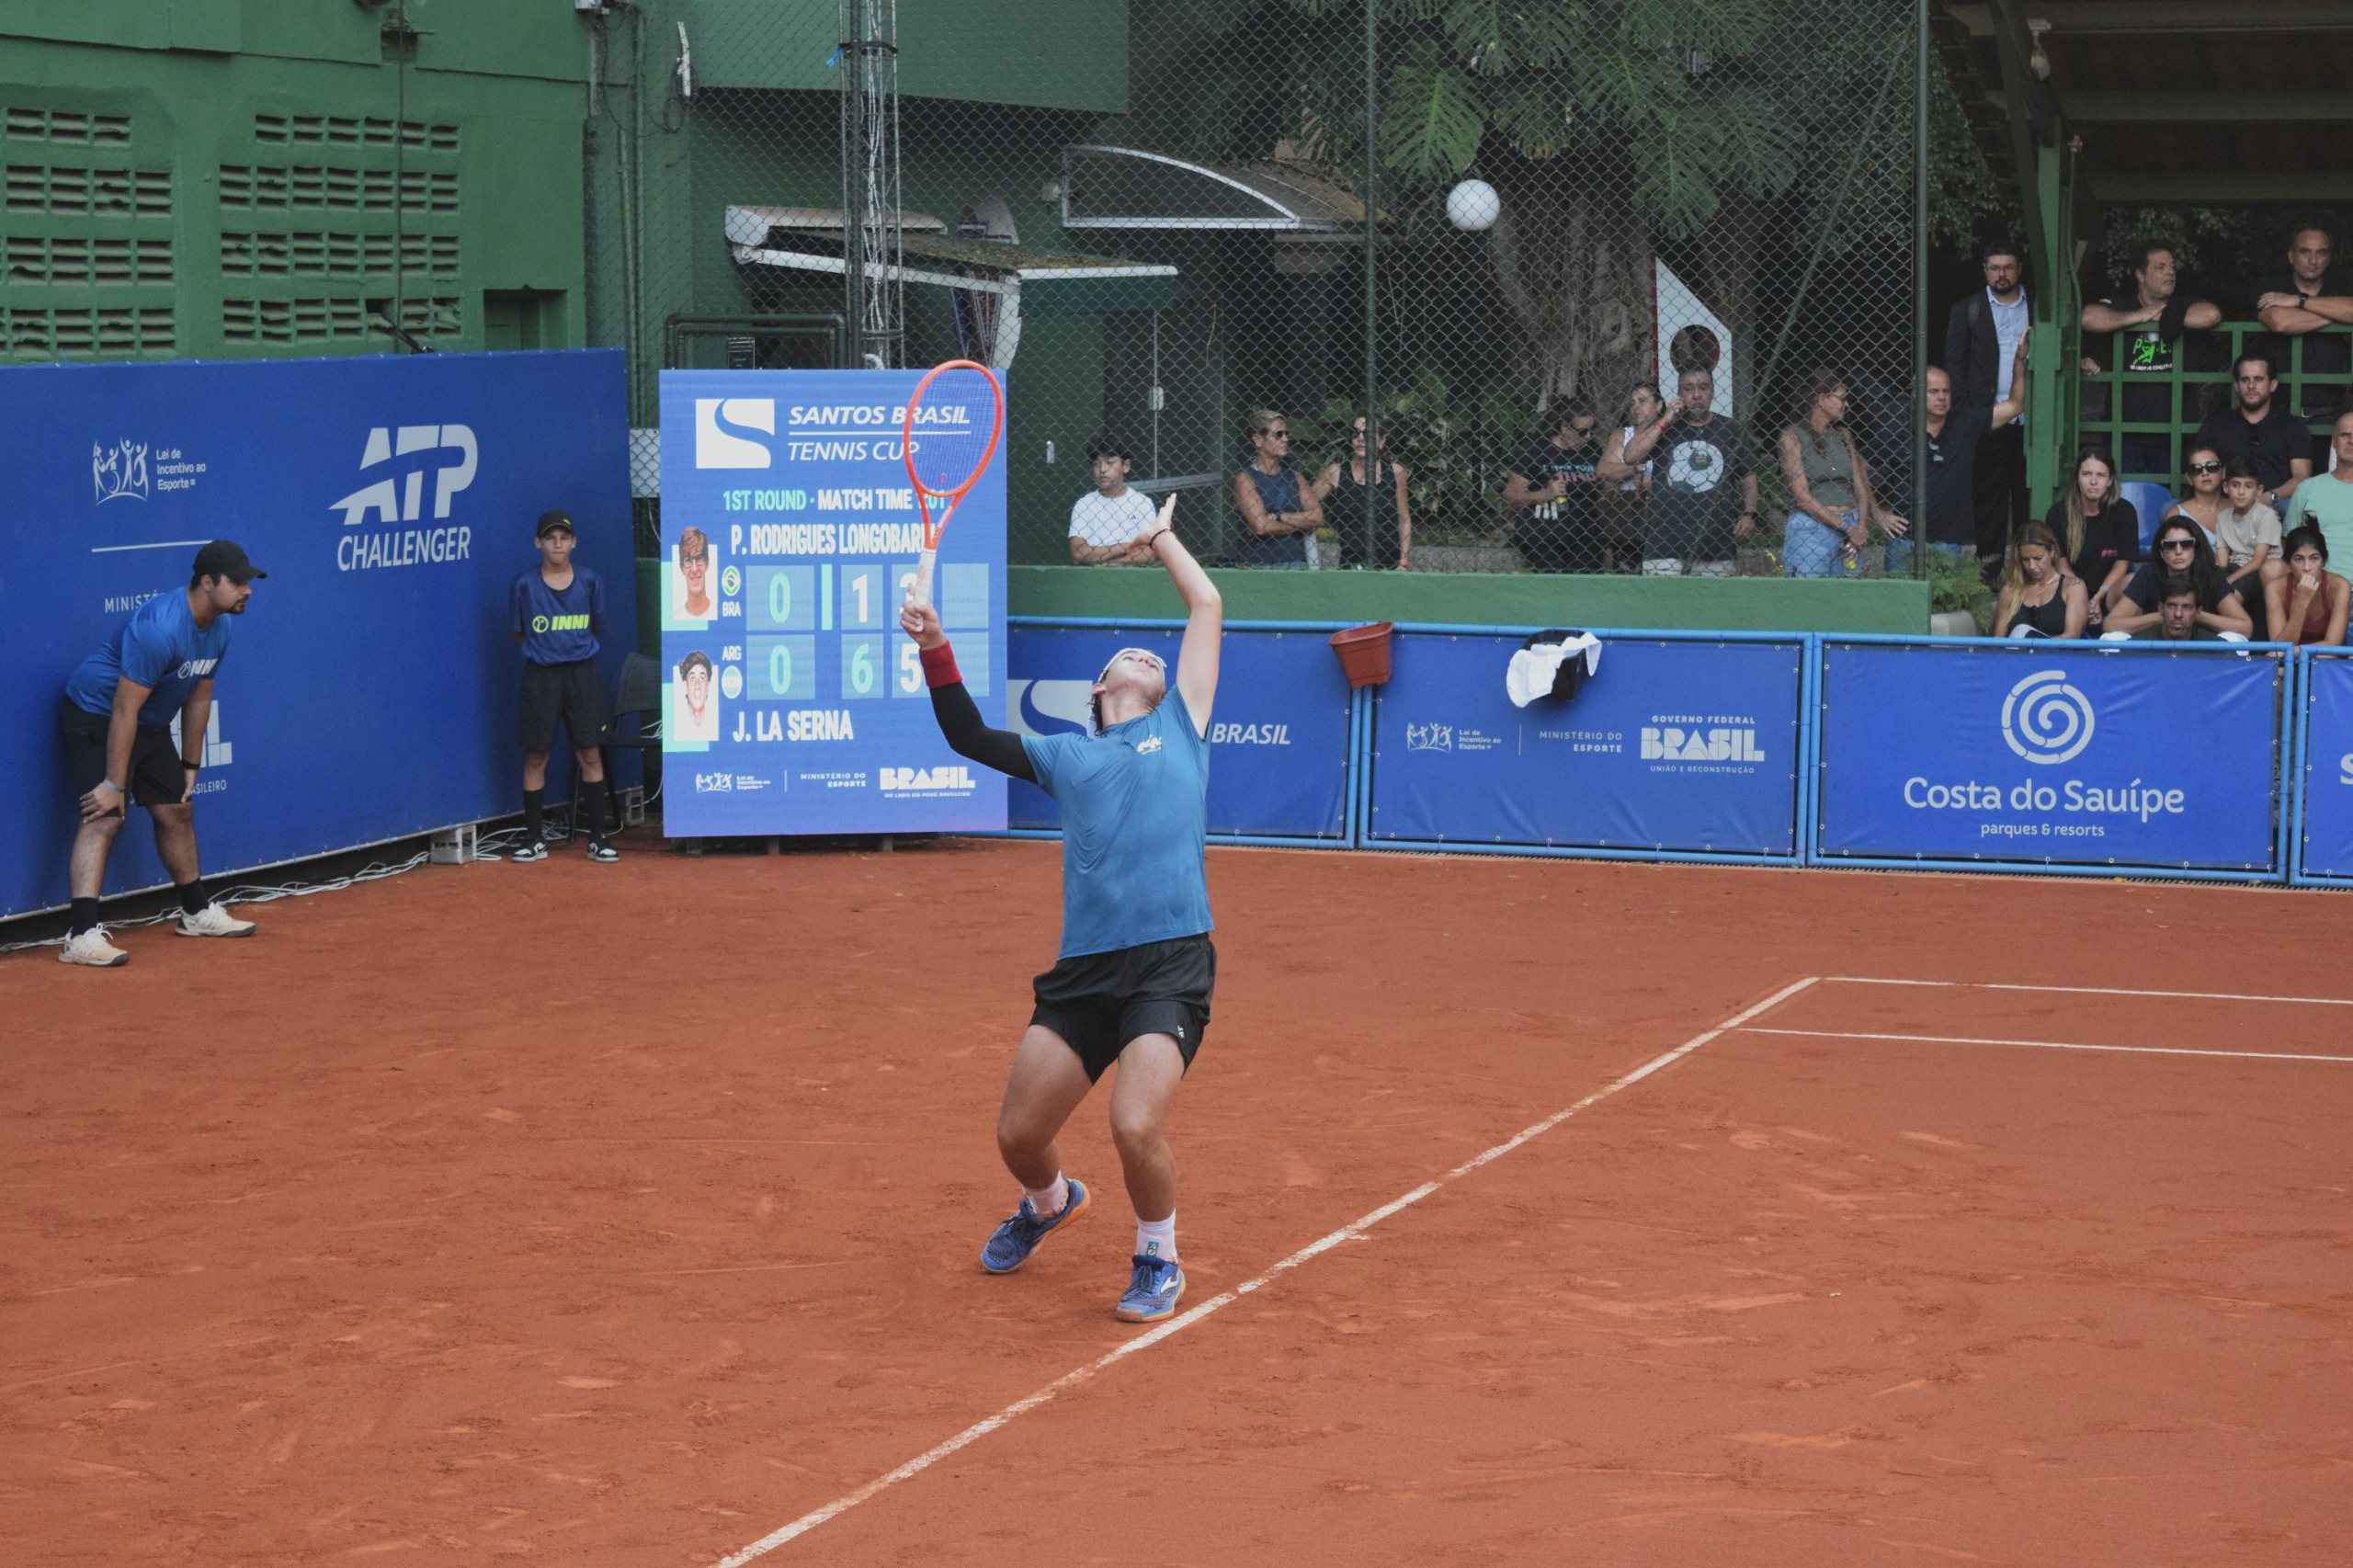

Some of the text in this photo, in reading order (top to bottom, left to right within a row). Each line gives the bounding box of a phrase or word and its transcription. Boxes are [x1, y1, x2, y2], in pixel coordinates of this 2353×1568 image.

[789, 405, 970, 425] SANTOS BRASIL
[156, 448, 181, 460] Lei de
[788, 441, 919, 460] TENNIS CUP
[157, 462, 206, 474] Incentivo ao
[328, 424, 478, 525] ATP
[157, 478, 189, 492] Esporte
[723, 490, 750, 510] 1ST
[755, 490, 806, 510] ROUND
[818, 490, 872, 510] MATCH
[876, 489, 913, 509] TIME
[732, 525, 746, 555] P.
[751, 524, 835, 554] RODRIGUES
[337, 527, 472, 572] CHALLENGER
[769, 574, 790, 623] 0
[852, 574, 868, 622] 1
[722, 602, 741, 617] BRA
[722, 645, 742, 661] ARG
[770, 643, 922, 694] 0 6 5
[733, 710, 854, 743] J. LA SERNA
[1652, 715, 1756, 724] GOVERNO FEDERAL
[1211, 723, 1290, 744] BRASIL
[1540, 731, 1622, 741] MINISTÉRIO DO
[1574, 744, 1622, 753] ESPORTE
[1641, 727, 1765, 762] BRASIL
[801, 772, 851, 780] MINISTÉRIO
[880, 767, 976, 790] BRASIL
[1651, 765, 1677, 773] UNIÃO
[1688, 766, 1755, 775] RECONSTRUÇÃO
[191, 779, 227, 795] ASILEIRO
[827, 780, 867, 789] ESPORTE
[1904, 777, 2185, 824] Costa do Sauípe
[1981, 824, 2105, 837] parques & resorts
